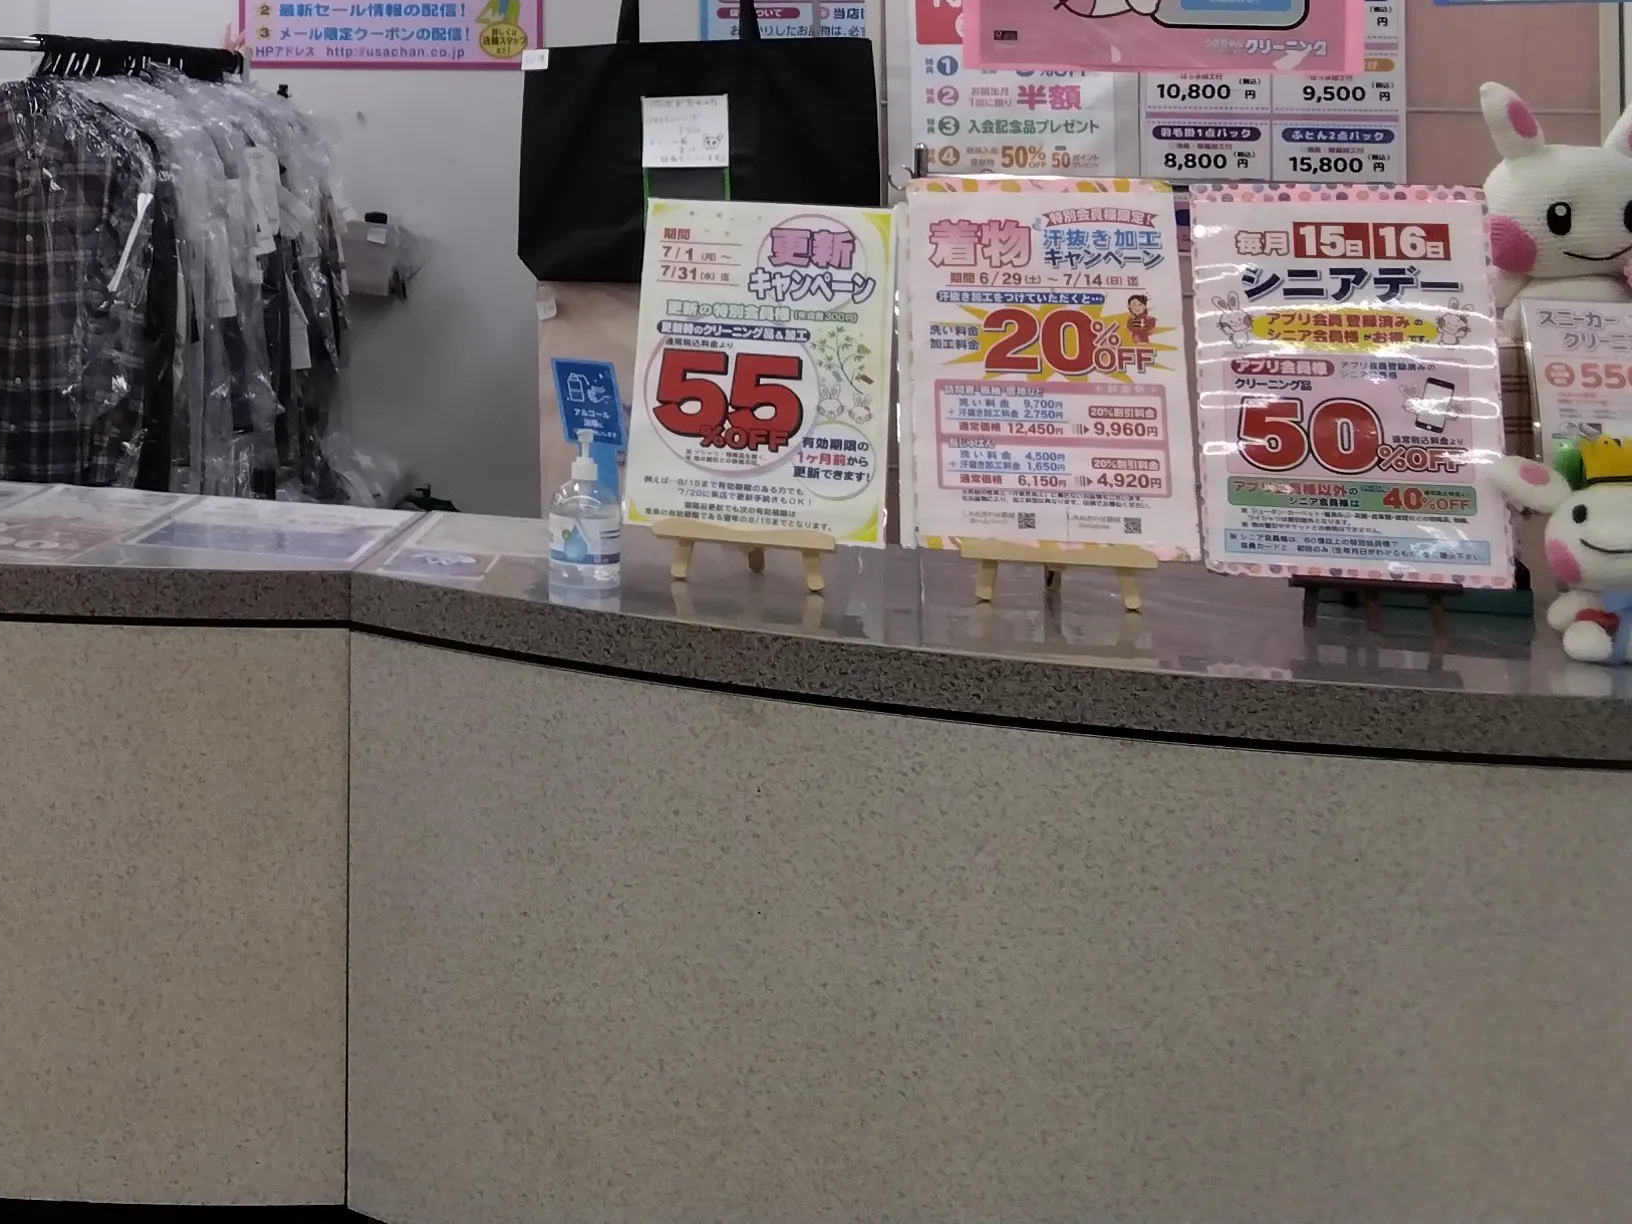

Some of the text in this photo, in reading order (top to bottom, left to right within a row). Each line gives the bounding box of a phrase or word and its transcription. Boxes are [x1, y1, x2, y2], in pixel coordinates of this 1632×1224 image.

[1017, 85, 1081, 110] 半額
[1156, 83, 1231, 102] 10,800
[1302, 85, 1366, 103] 9,500
[968, 119, 1099, 135] 入会記念品プレゼント
[1164, 153, 1227, 170] 8,800
[1289, 157, 1363, 173] 15,800
[664, 228, 690, 240] 期間
[1044, 229, 1162, 249] 汗抜き加工
[1235, 225, 1445, 259] 毎月 15日 16日
[770, 228, 855, 269] 更新
[929, 220, 1032, 268] 着物
[1044, 250, 1164, 269] キャンペーン
[748, 268, 876, 303] キャンペーン
[1241, 266, 1462, 303] シニアデー
[1538, 310, 1616, 328] スニーカー
[929, 325, 979, 336] 洗い料金
[929, 339, 980, 350] 加工料金
[1564, 332, 1632, 351] クリーニ
[653, 348, 803, 439] 55
[1235, 379, 1312, 390] クリーニング品
[1094, 422, 1158, 437] 9,960円
[1239, 397, 1384, 474] 50
[803, 437, 869, 451] 有効期限の
[1097, 474, 1161, 488] 4,920円
[1382, 487, 1423, 509] 40
